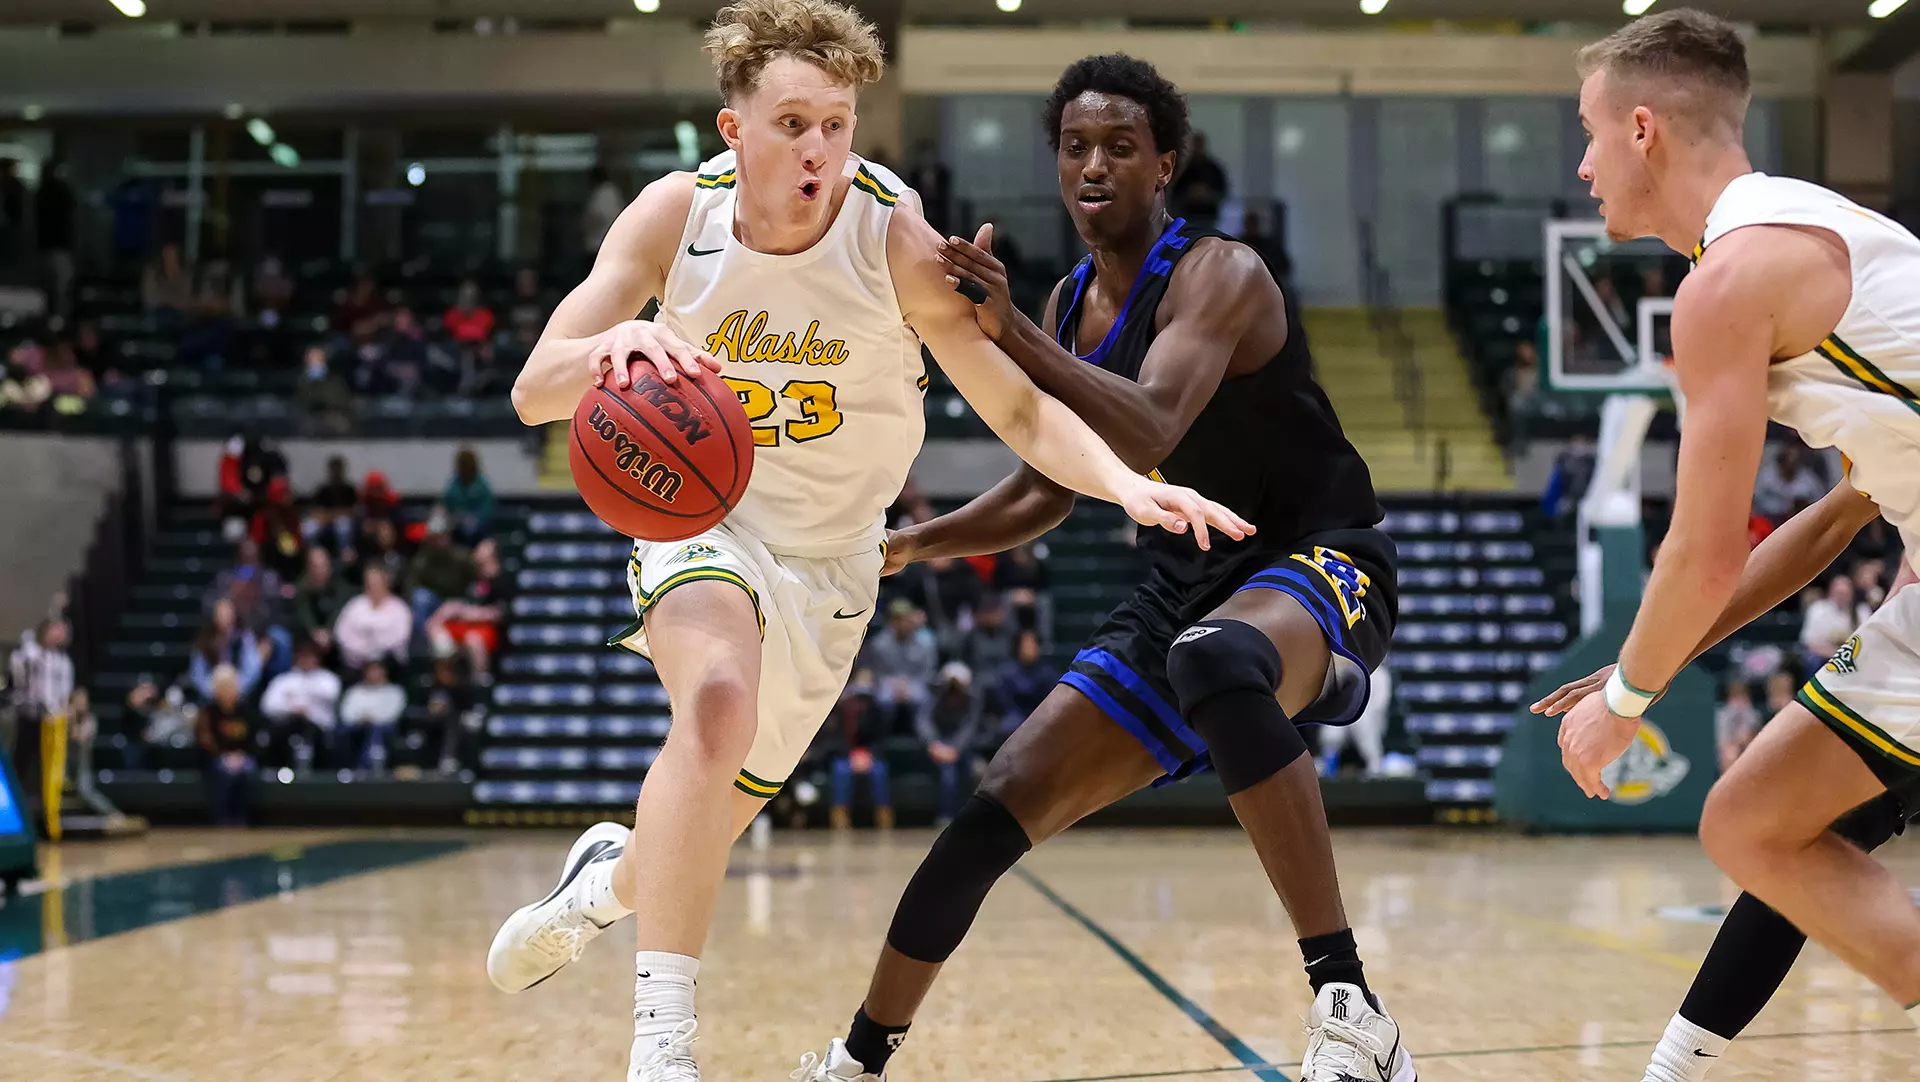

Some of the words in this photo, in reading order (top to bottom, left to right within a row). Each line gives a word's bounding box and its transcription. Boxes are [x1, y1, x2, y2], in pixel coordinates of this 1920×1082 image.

[704, 310, 849, 366] Alaska
[631, 372, 712, 446] NCAA
[720, 375, 844, 448] 23
[587, 401, 684, 504] Wilson
